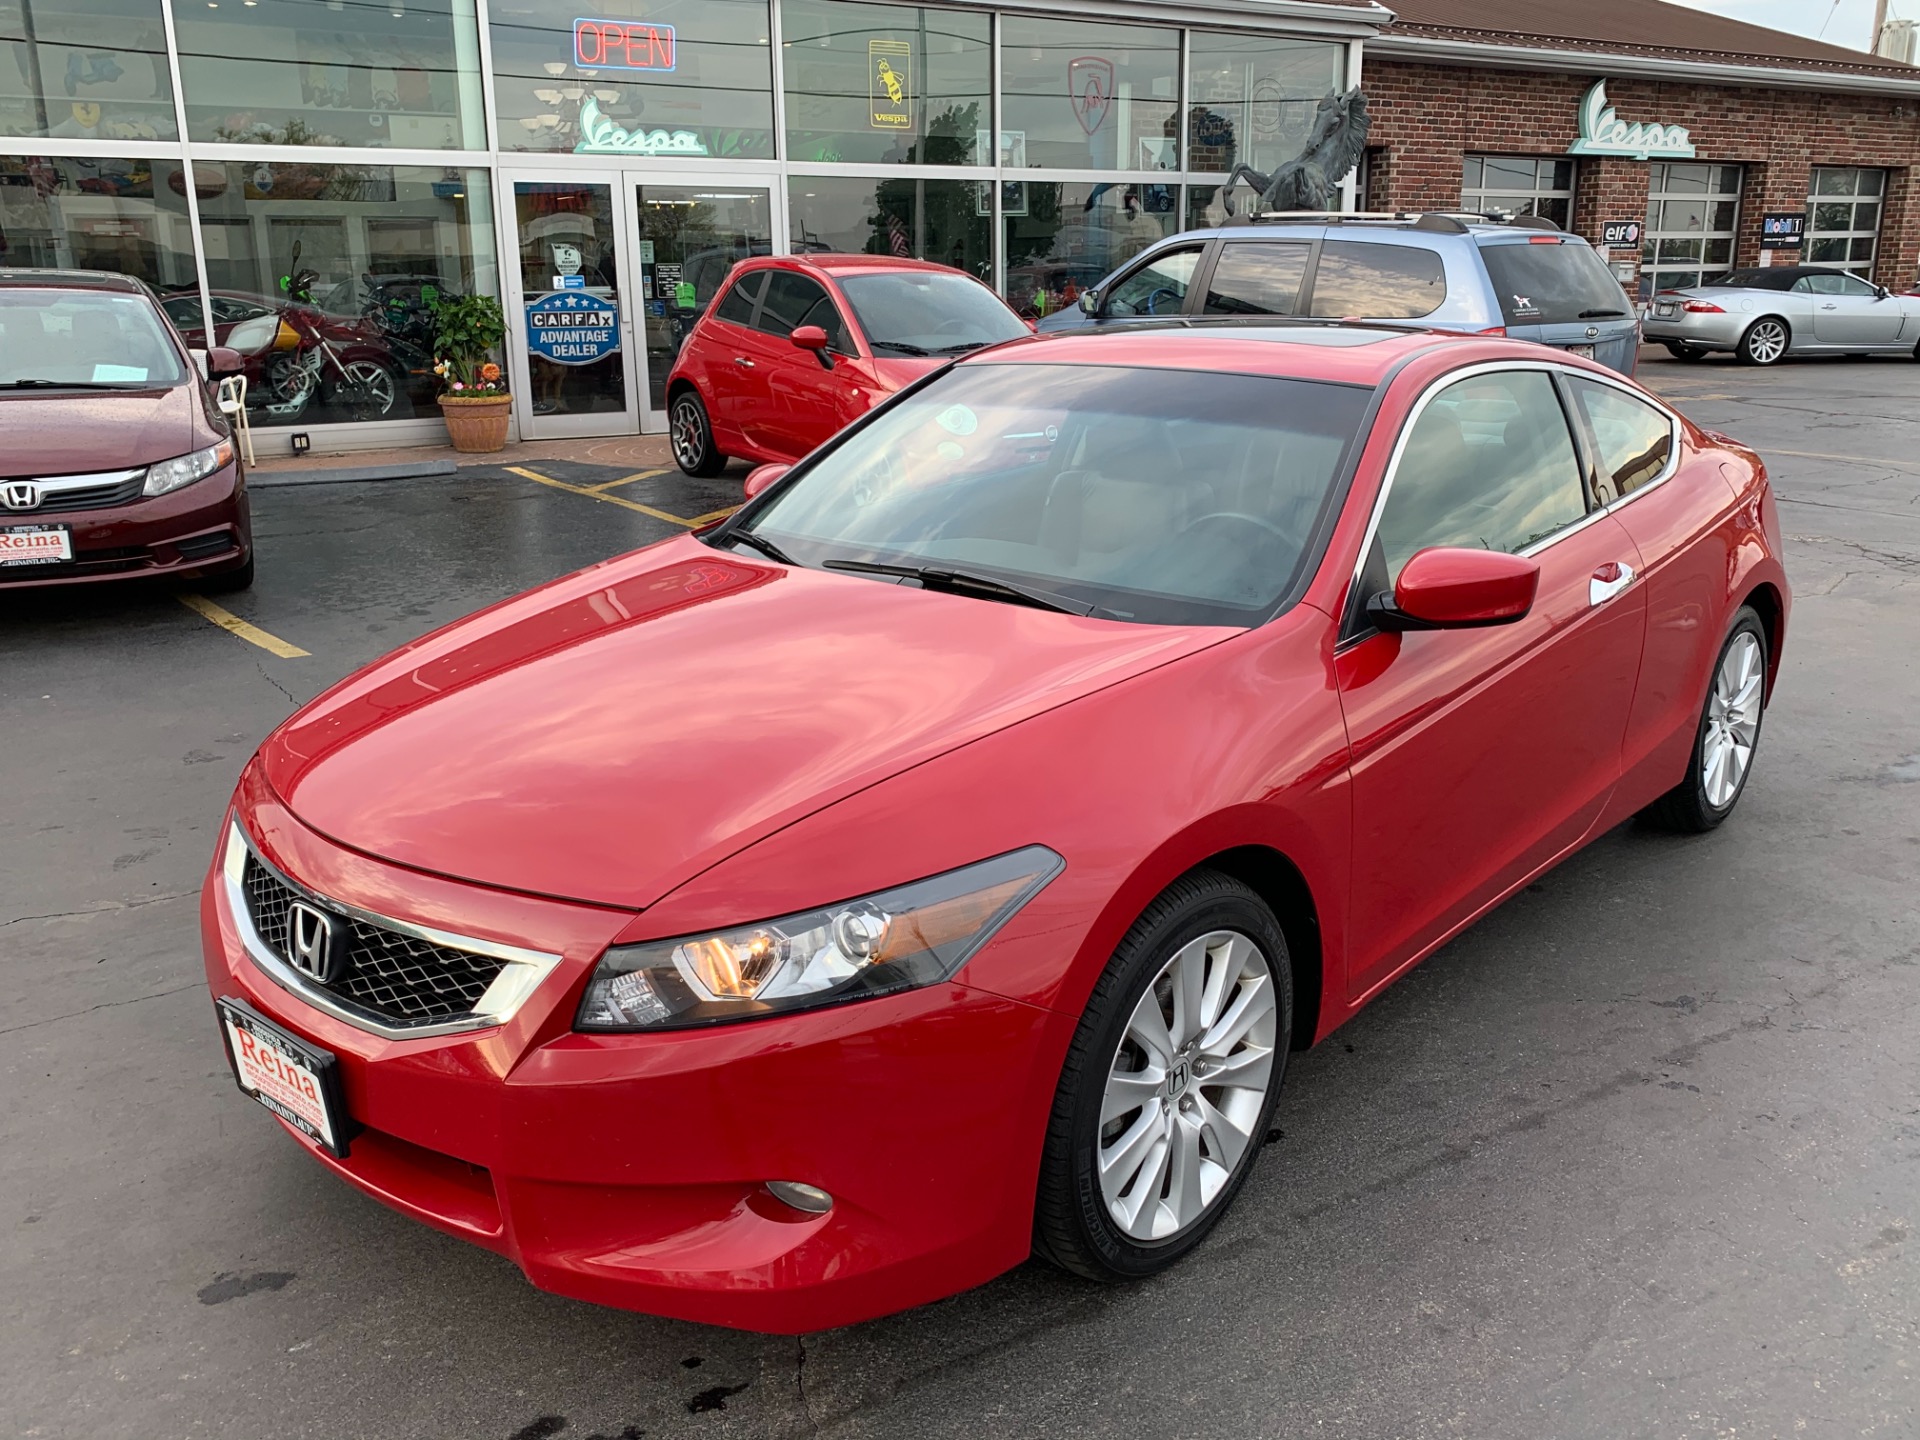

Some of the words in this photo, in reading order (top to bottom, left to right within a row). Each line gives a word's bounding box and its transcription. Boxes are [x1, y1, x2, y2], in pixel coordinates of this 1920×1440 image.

[579, 22, 671, 67] OPEN
[874, 113, 908, 123] Vespa
[1576, 79, 1694, 159] Vespa
[578, 98, 705, 156] Vespa
[1765, 218, 1792, 233] Mobil
[1605, 226, 1627, 241] elf
[533, 313, 611, 327] CARFAX
[539, 330, 609, 343] ADVANTAGE
[552, 344, 598, 356] DEALER
[236, 1026, 320, 1104] Reina
[1079, 1176, 1111, 1249] MICHELIN
